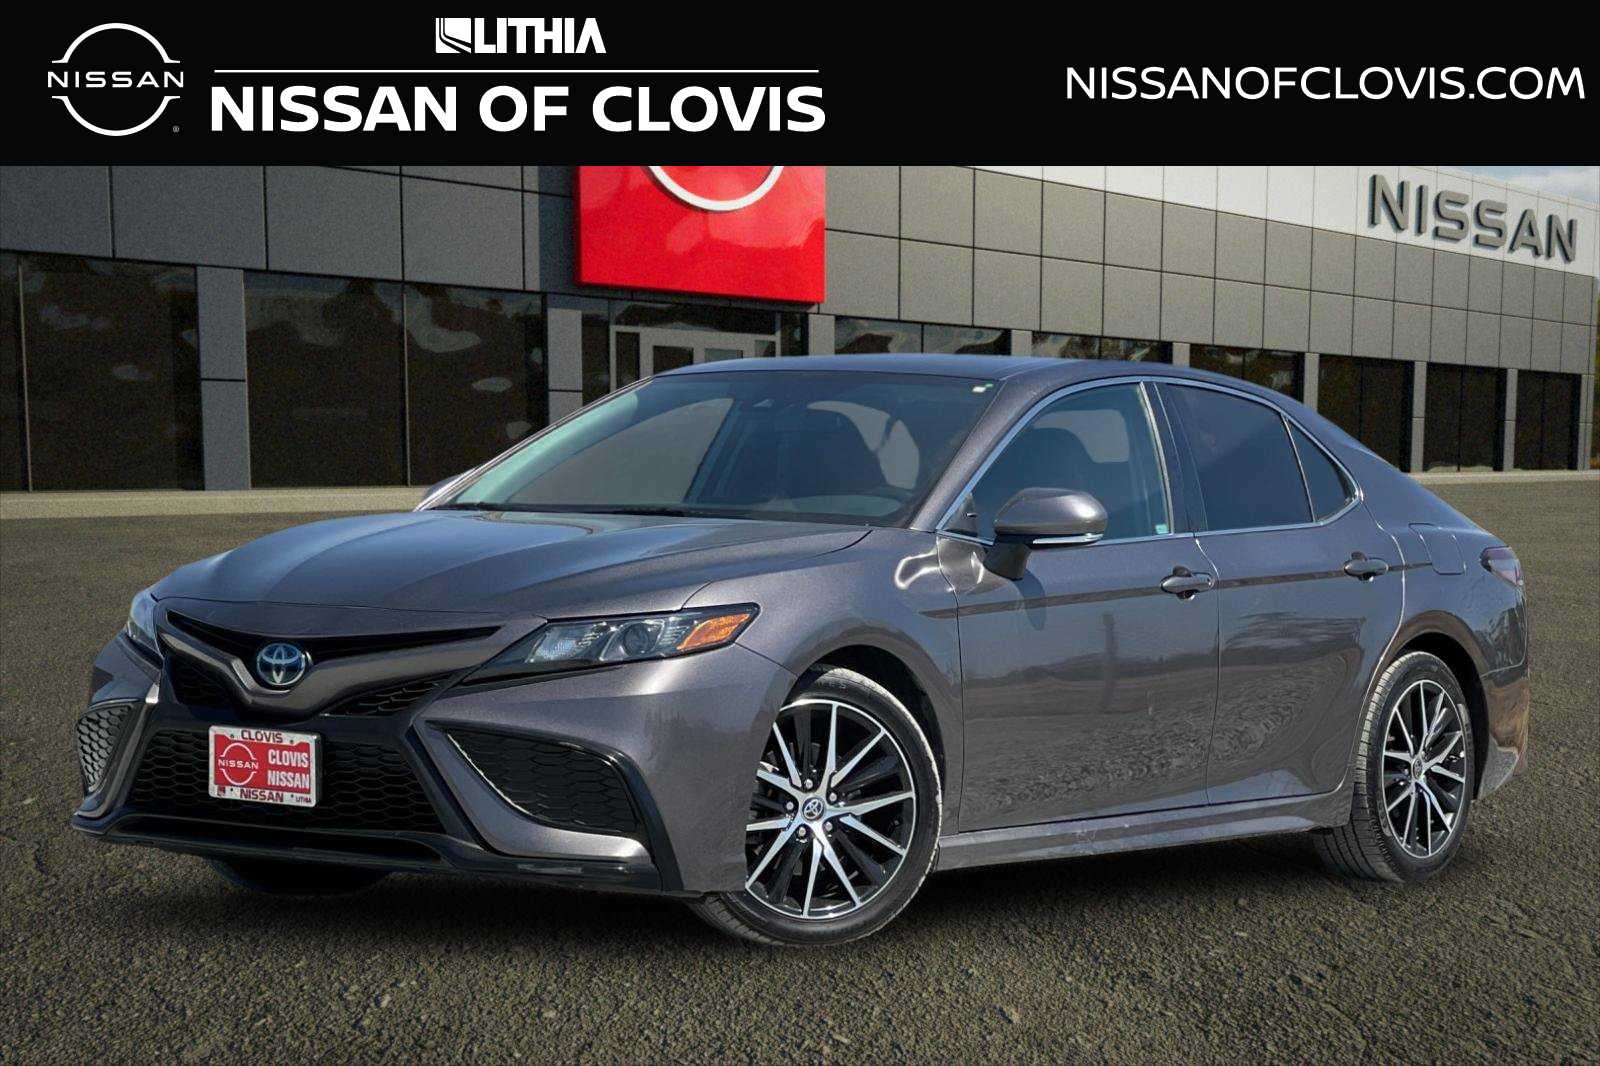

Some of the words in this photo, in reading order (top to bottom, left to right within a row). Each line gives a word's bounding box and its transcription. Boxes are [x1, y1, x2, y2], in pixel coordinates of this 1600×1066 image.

[1368, 174, 1578, 264] NISSAN
[241, 729, 283, 743] CLOVIS
[218, 758, 259, 769] NISSAN
[268, 749, 308, 768] CLOVIS
[267, 770, 309, 788] NISSAN
[240, 788, 284, 802] NISSAN
